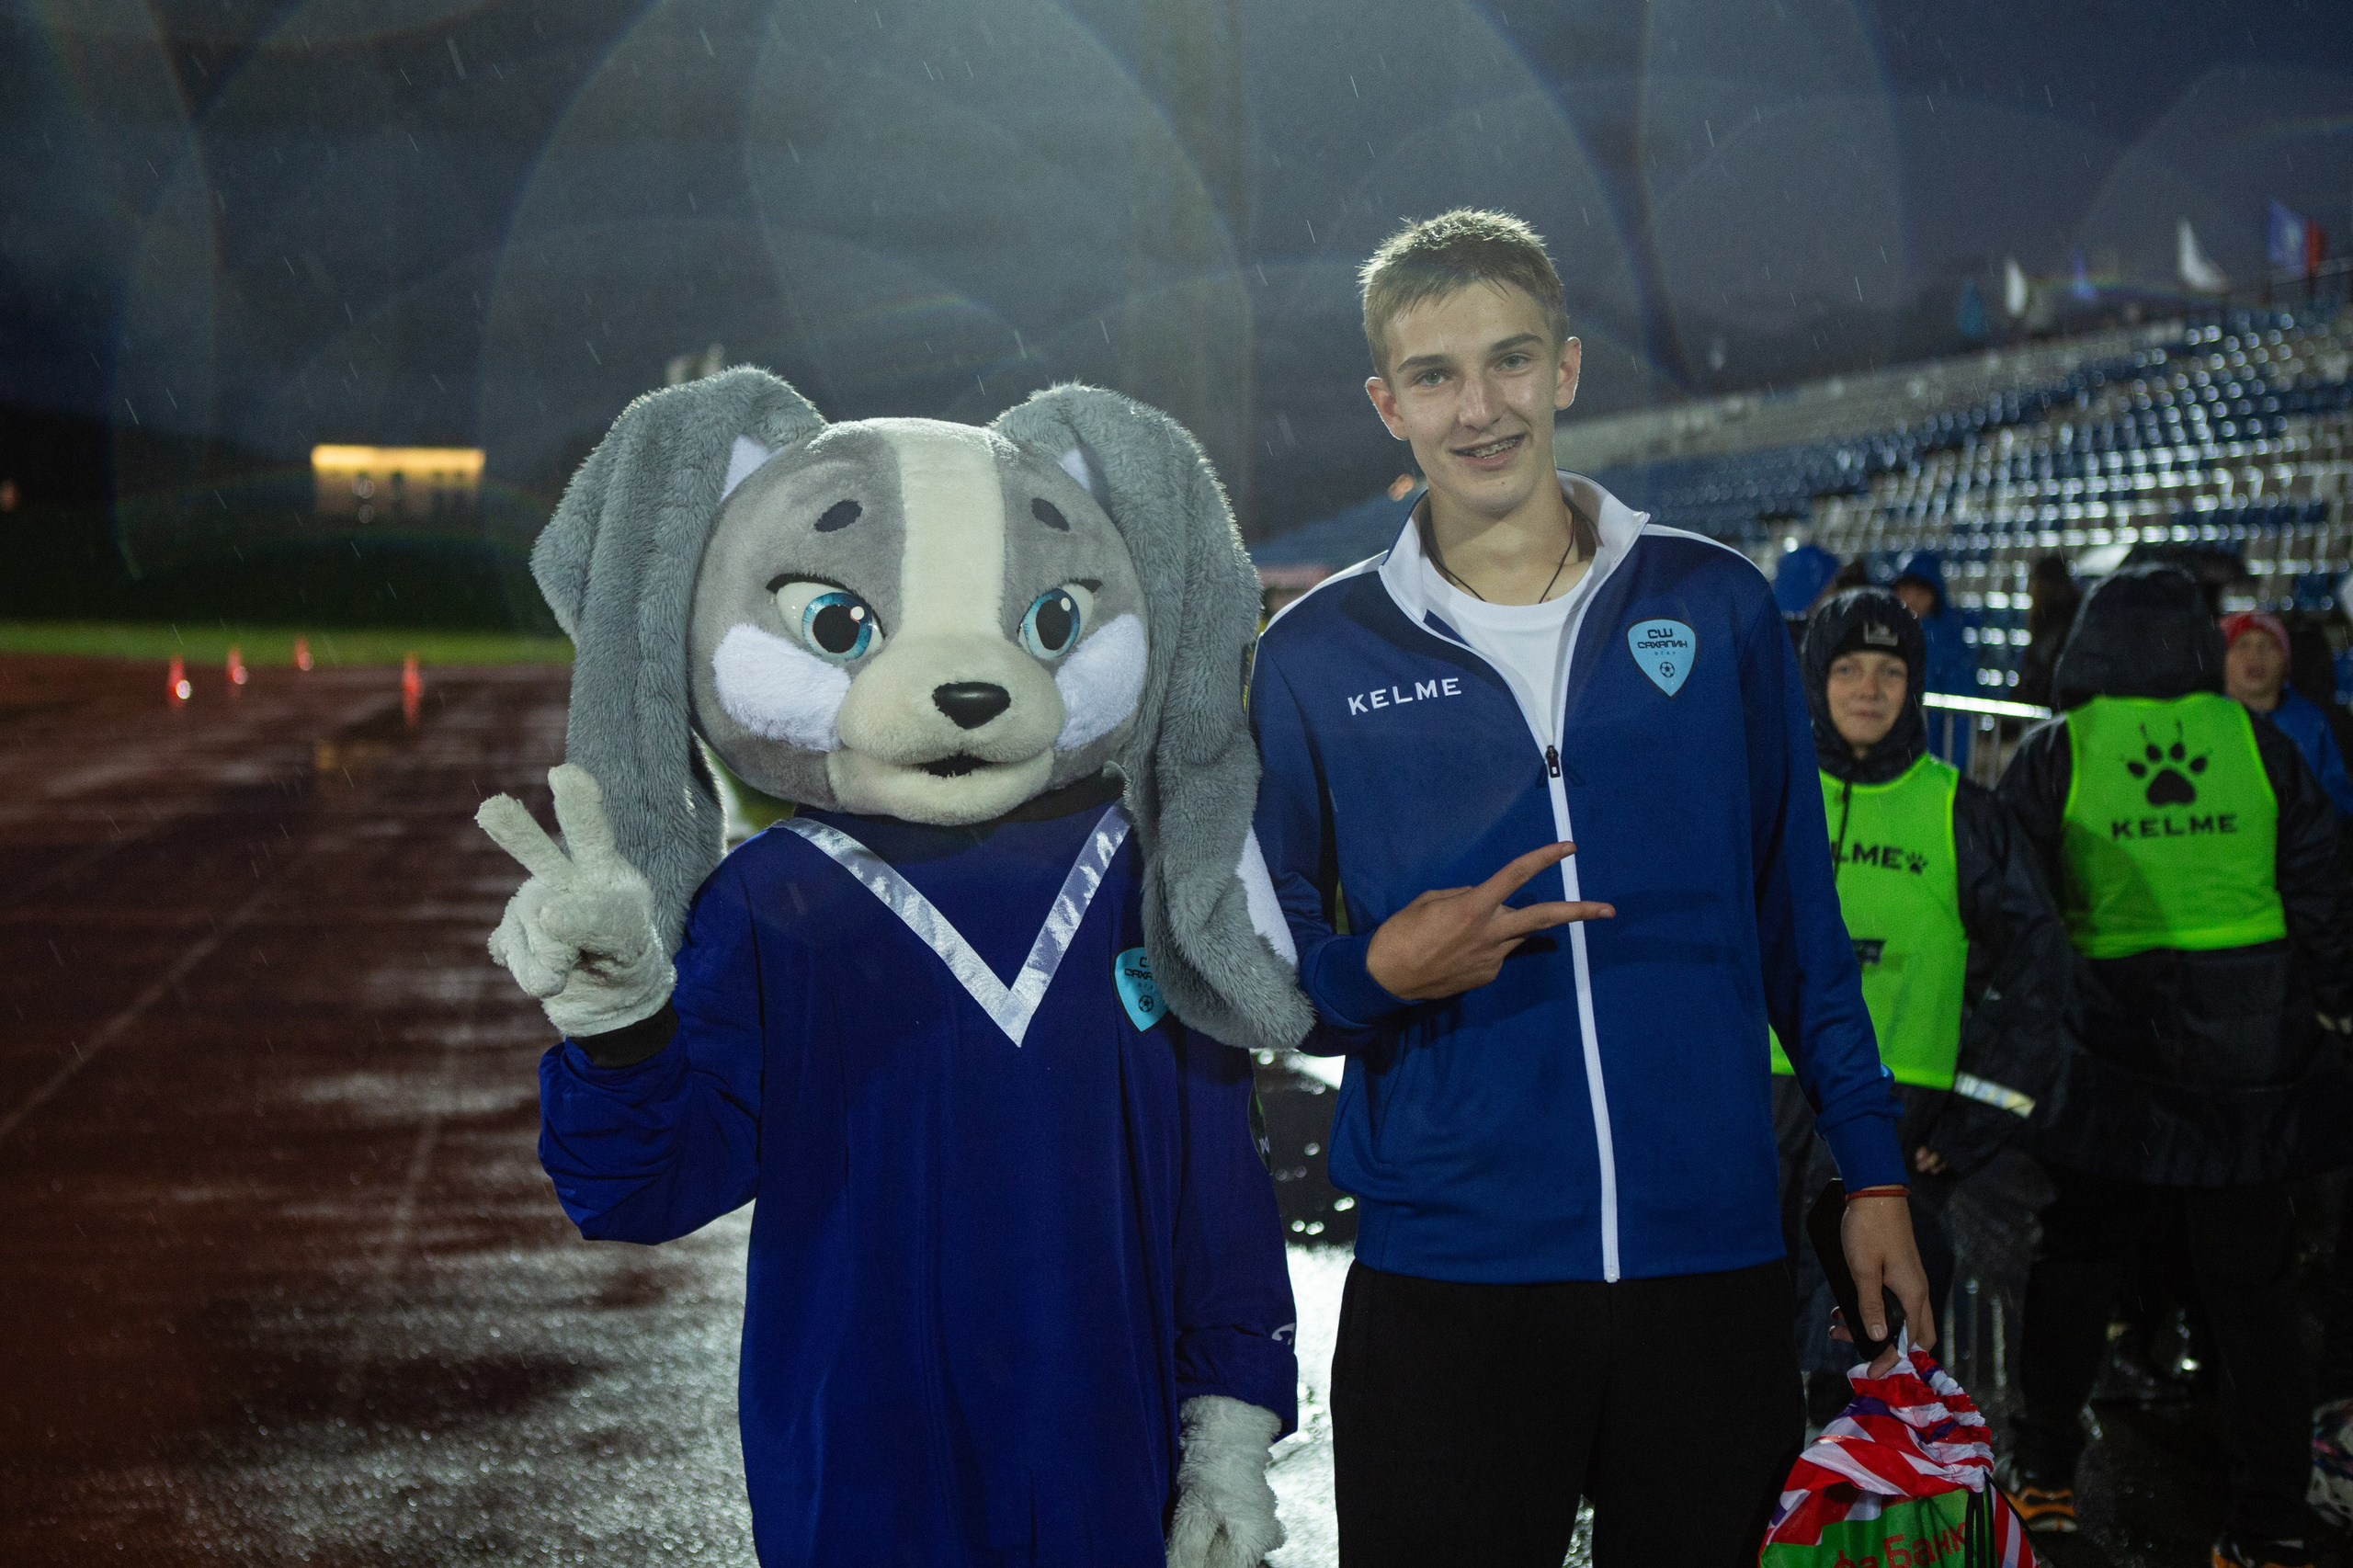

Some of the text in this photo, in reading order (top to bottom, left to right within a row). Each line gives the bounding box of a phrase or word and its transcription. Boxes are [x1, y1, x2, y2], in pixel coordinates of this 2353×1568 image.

[1647, 628, 1674, 639] СШ
[1637, 640, 1688, 649] САХАЛИН
[1347, 677, 1461, 716] KELME
[2111, 813, 2237, 839] KELME
